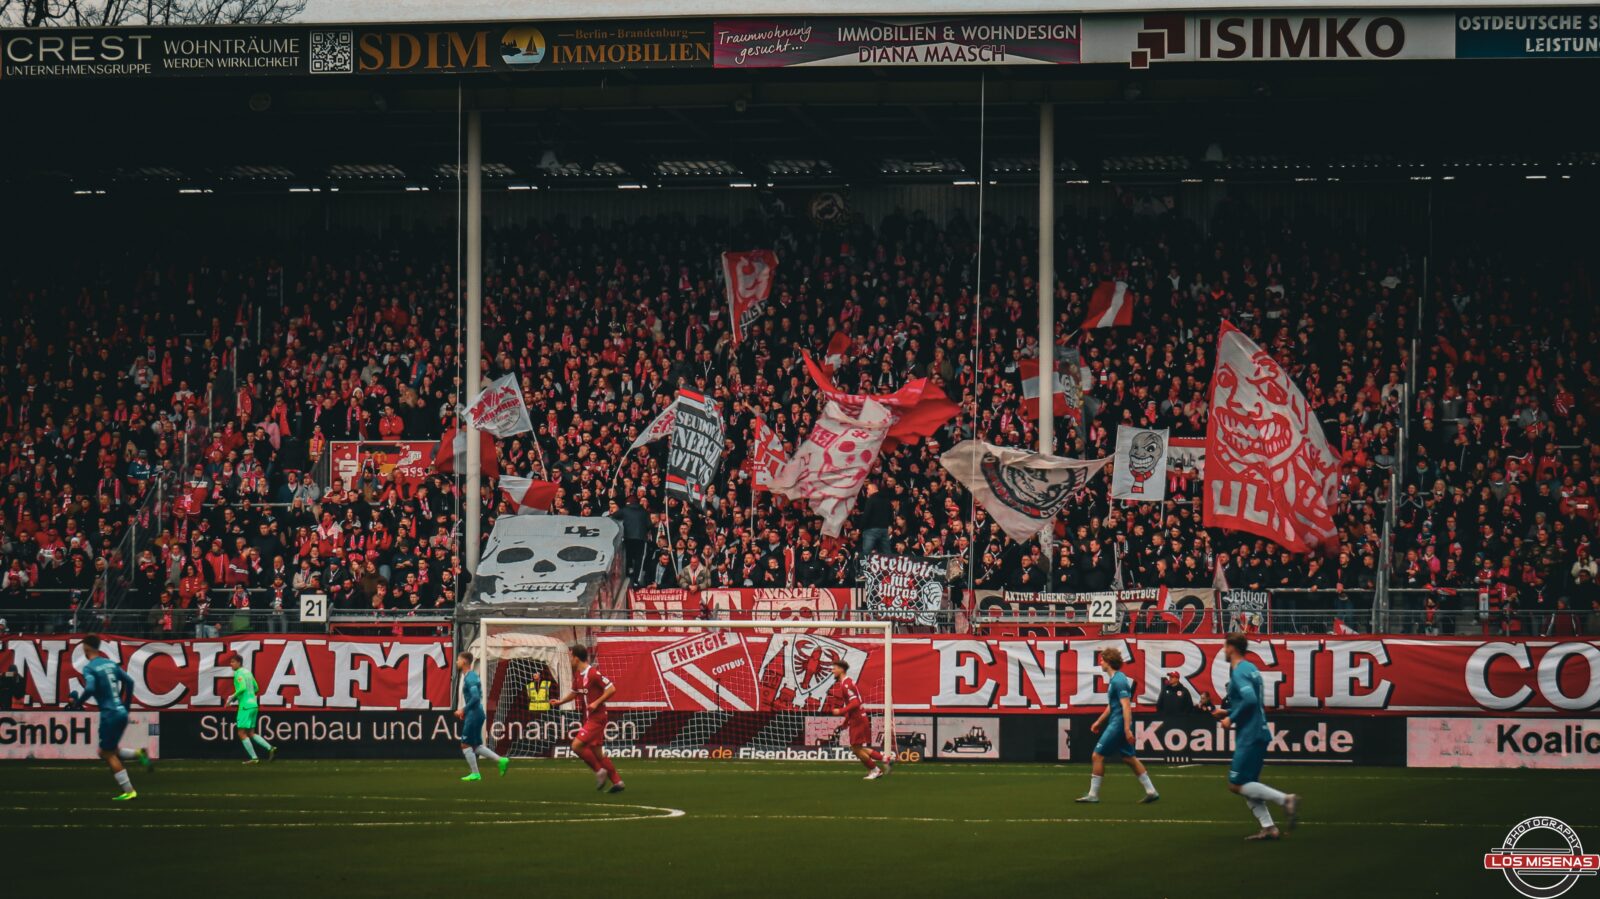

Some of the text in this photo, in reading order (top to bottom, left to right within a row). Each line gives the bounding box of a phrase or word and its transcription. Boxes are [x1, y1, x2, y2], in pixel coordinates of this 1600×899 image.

[1458, 15, 1600, 31] OSTDEUTSCHE S
[718, 25, 812, 46] Traumwohnung
[837, 25, 1078, 42] IMMOBILIEN & WOHNDESIGN
[1200, 16, 1406, 60] ISIMKO
[6, 35, 152, 62] CREST
[163, 36, 300, 55] WOHNTRÄUME
[358, 31, 492, 71] SDIM
[552, 41, 711, 65] IMMOBILIEN
[858, 45, 1006, 64] DIANA MAASCH
[1525, 37, 1600, 53] LEISTUN
[6, 63, 152, 76] UNTERNEHMENSGRUPPE
[163, 56, 300, 69] WERDEN WIRKLICHKEIT
[870, 554, 933, 577] Freiheit
[890, 573, 912, 588] für
[878, 583, 918, 600] Ultras
[305, 600, 323, 617] 21
[892, 596, 903, 608] &
[1092, 600, 1112, 617] 22
[668, 632, 729, 665] ENERGIE
[0, 639, 448, 709] NSCHAFT
[711, 657, 745, 676] COTTBUS
[931, 639, 1394, 709] ENERGIE
[1464, 640, 1600, 712] CO
[0, 716, 92, 745] GmbH
[199, 714, 637, 741] Strßenbau und Auenanlaen
[1134, 720, 1354, 753] Koalik.de
[553, 744, 733, 759] Eisbach Tresore.de
[738, 746, 828, 760] Eisenbach
